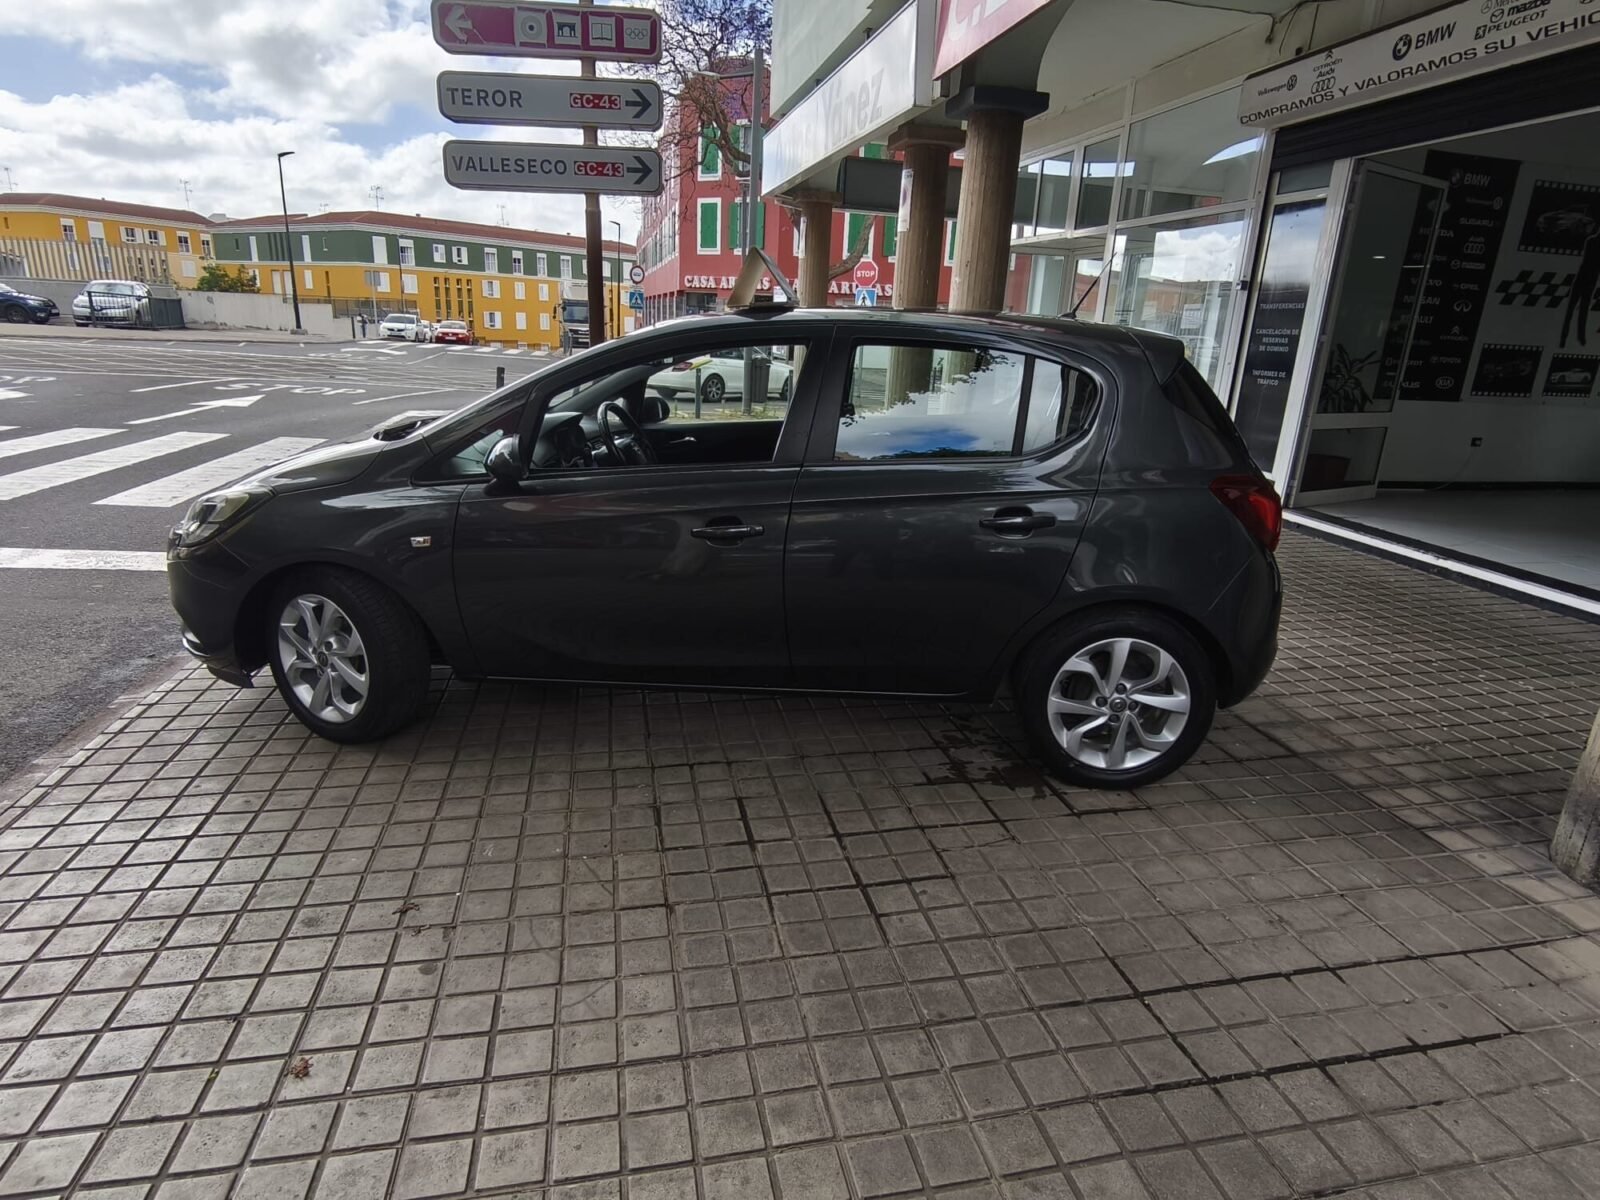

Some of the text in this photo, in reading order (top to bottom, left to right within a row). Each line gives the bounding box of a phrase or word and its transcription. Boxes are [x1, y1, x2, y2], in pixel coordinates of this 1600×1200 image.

[1487, 9, 1548, 34] PEUGEOT
[1415, 22, 1457, 50] BMW
[1316, 67, 1335, 79] Audi
[1240, 91, 1335, 125] COMPRAMOS
[1339, 85, 1349, 97] Y
[1355, 48, 1477, 92] VALORAMOS
[1485, 36, 1516, 54] SU
[446, 87, 621, 110] TEROR GC-43
[452, 155, 625, 177] VALLESECO GC-43
[1463, 173, 1492, 187] BMW
[856, 270, 875, 278] STOP
[684, 275, 716, 288] CASA
[1260, 302, 1304, 310] TRANSFERENCIAS
[1252, 369, 1277, 377] INFORMES
[213, 383, 366, 395] STOP
